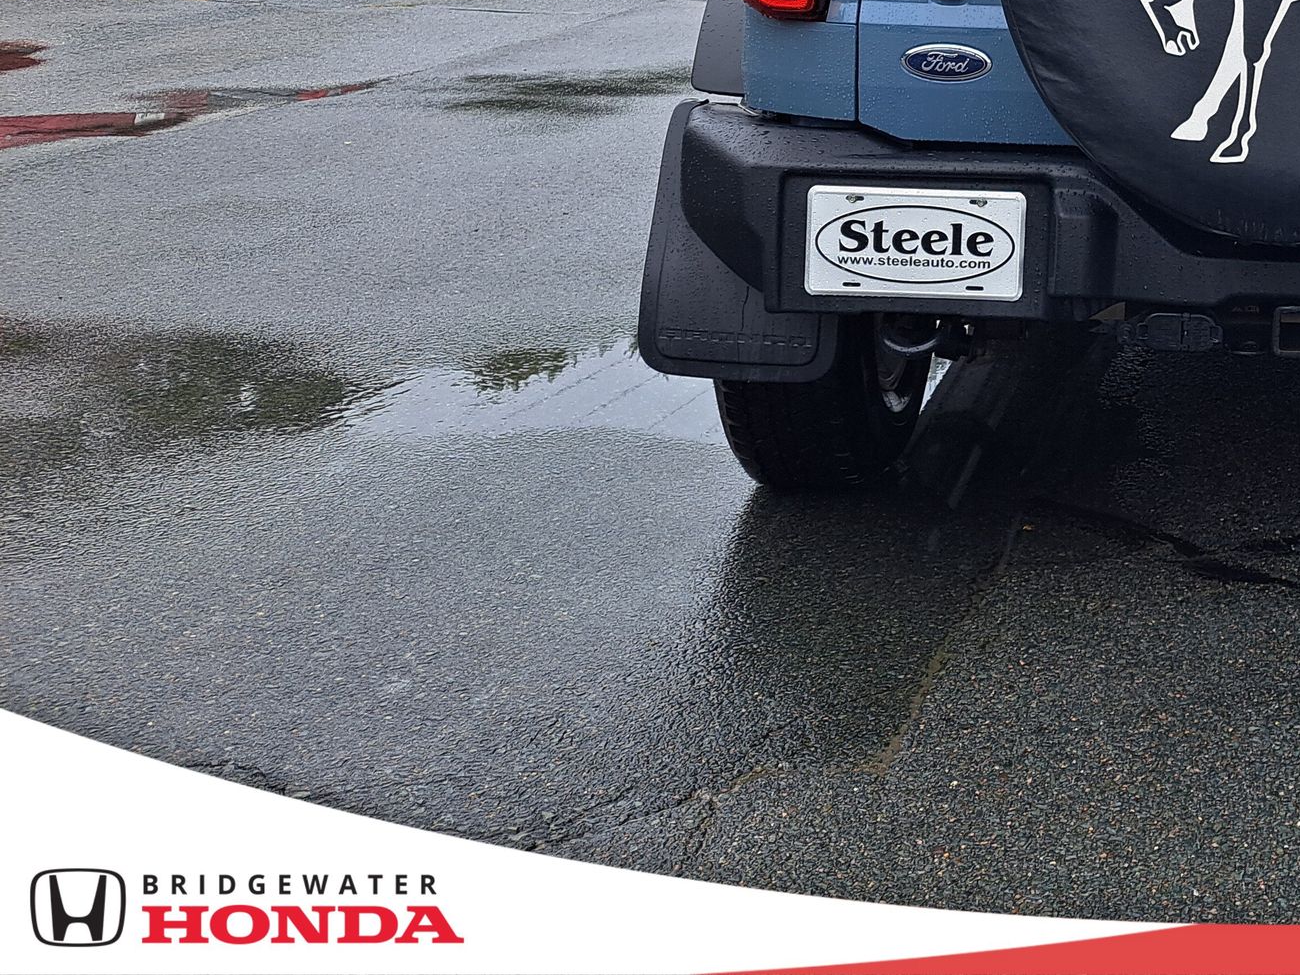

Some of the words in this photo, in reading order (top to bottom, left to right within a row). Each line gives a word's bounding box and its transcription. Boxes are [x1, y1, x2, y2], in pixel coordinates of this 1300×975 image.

[921, 51, 970, 73] Ford
[838, 219, 994, 256] Steele
[837, 255, 991, 270] www.steeleauto.com
